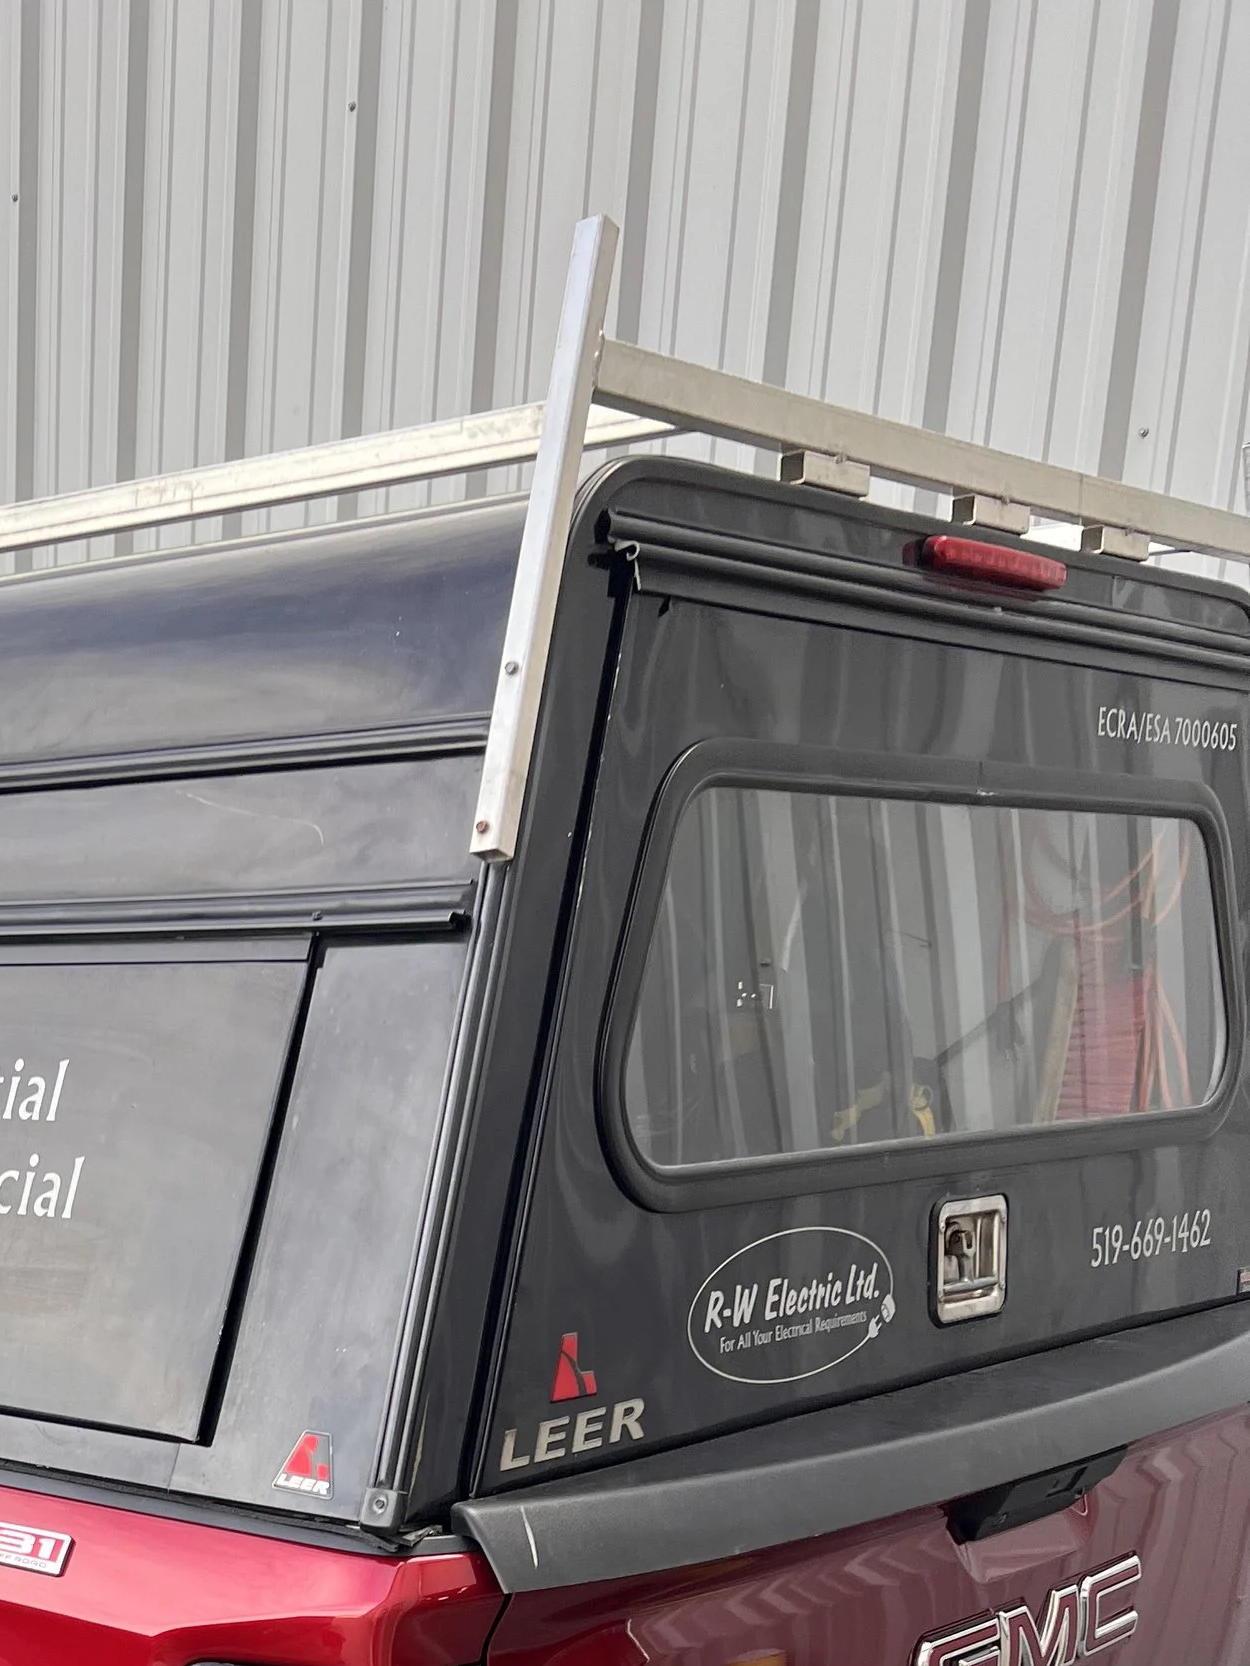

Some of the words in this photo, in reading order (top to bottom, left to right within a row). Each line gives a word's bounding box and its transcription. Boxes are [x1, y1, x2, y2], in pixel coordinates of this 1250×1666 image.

[1097, 706, 1171, 744] ECRA/ESA
[1174, 717, 1238, 751] 7000605
[1090, 1209, 1212, 1269] 519-669-1462
[704, 1283, 758, 1333] R-W
[764, 1272, 842, 1321] Electric
[845, 1262, 879, 1305] Ltd.
[719, 1336, 735, 1354] For
[737, 1333, 751, 1350] All
[752, 1330, 773, 1347] Your
[775, 1320, 813, 1342] Electrical
[814, 1310, 867, 1333] Requirements
[499, 1398, 647, 1473] LEER
[276, 1473, 330, 1495] LEER
